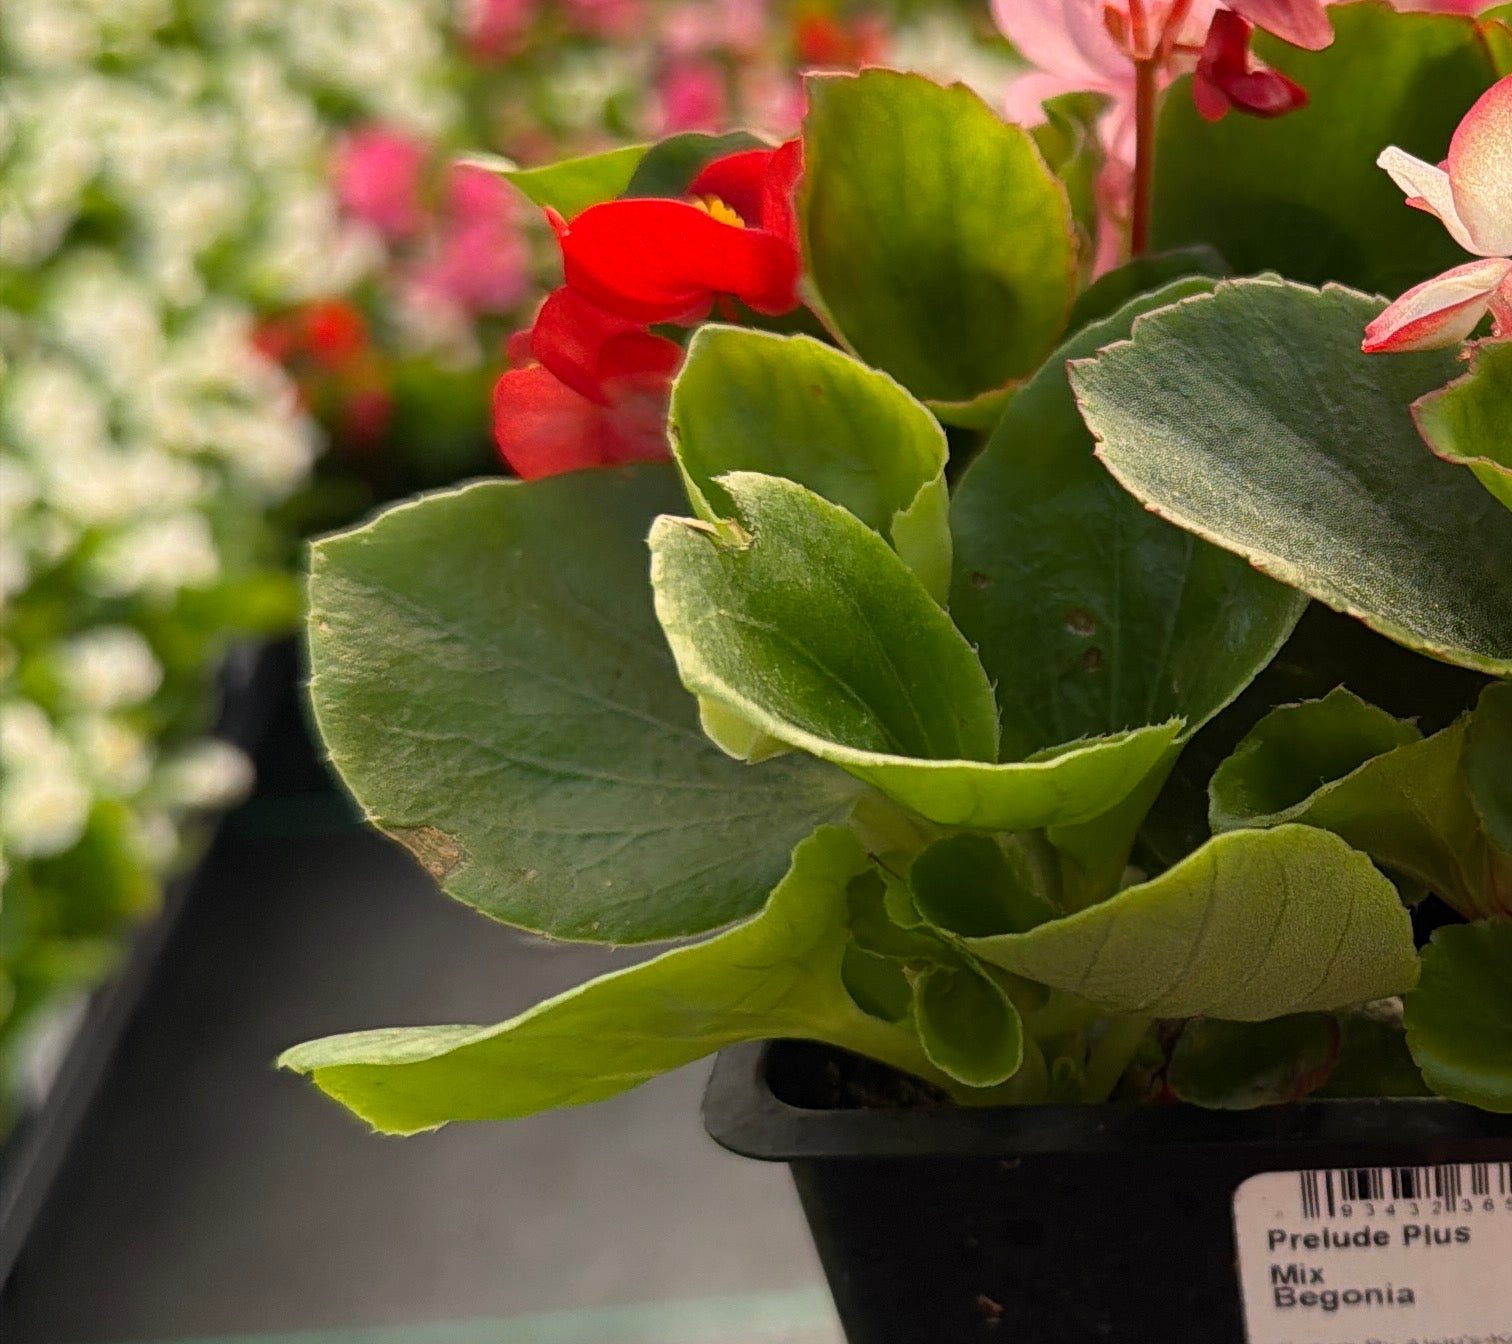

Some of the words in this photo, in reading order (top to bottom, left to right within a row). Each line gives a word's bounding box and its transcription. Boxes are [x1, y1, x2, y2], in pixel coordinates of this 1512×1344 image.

[1268, 1225, 1391, 1251] Prelude
[1403, 1222, 1472, 1246] Plus
[1271, 1263, 1325, 1285] Mix
[1274, 1282, 1415, 1311] Begonia
